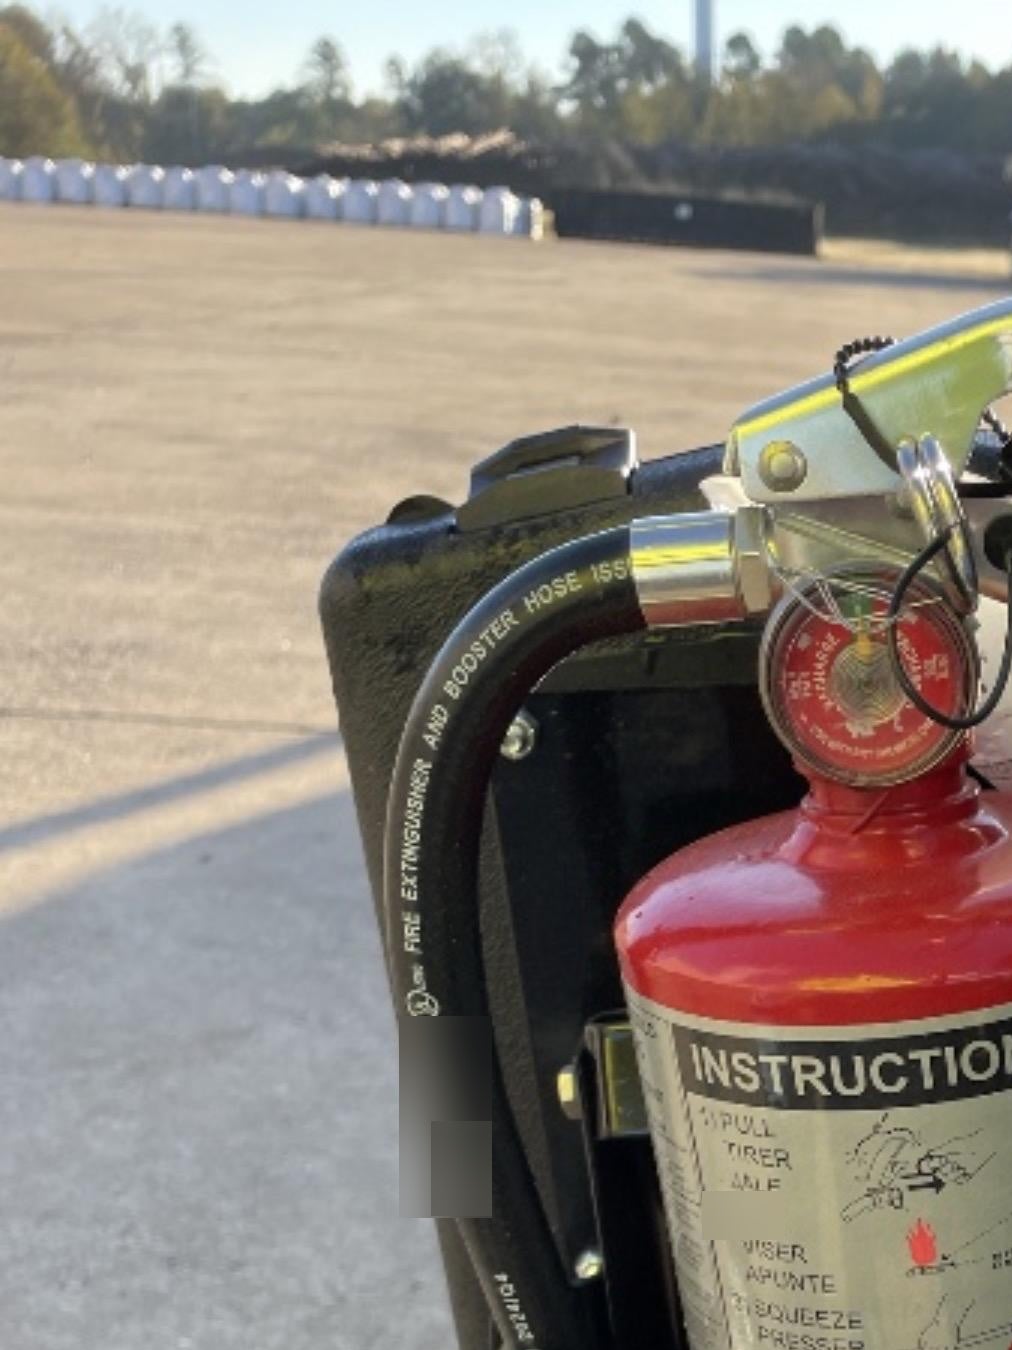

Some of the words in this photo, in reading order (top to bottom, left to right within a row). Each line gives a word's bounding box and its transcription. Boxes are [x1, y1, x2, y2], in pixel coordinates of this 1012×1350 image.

[524, 571, 583, 613] HOSE
[443, 608, 520, 700] BOOSTER
[422, 704, 448, 750] AND
[401, 758, 432, 901] EXTINGUISHER
[404, 912, 422, 953] FIRE
[745, 1263, 837, 1294] APUNTE
[754, 1298, 864, 1330] SQUEEZE
